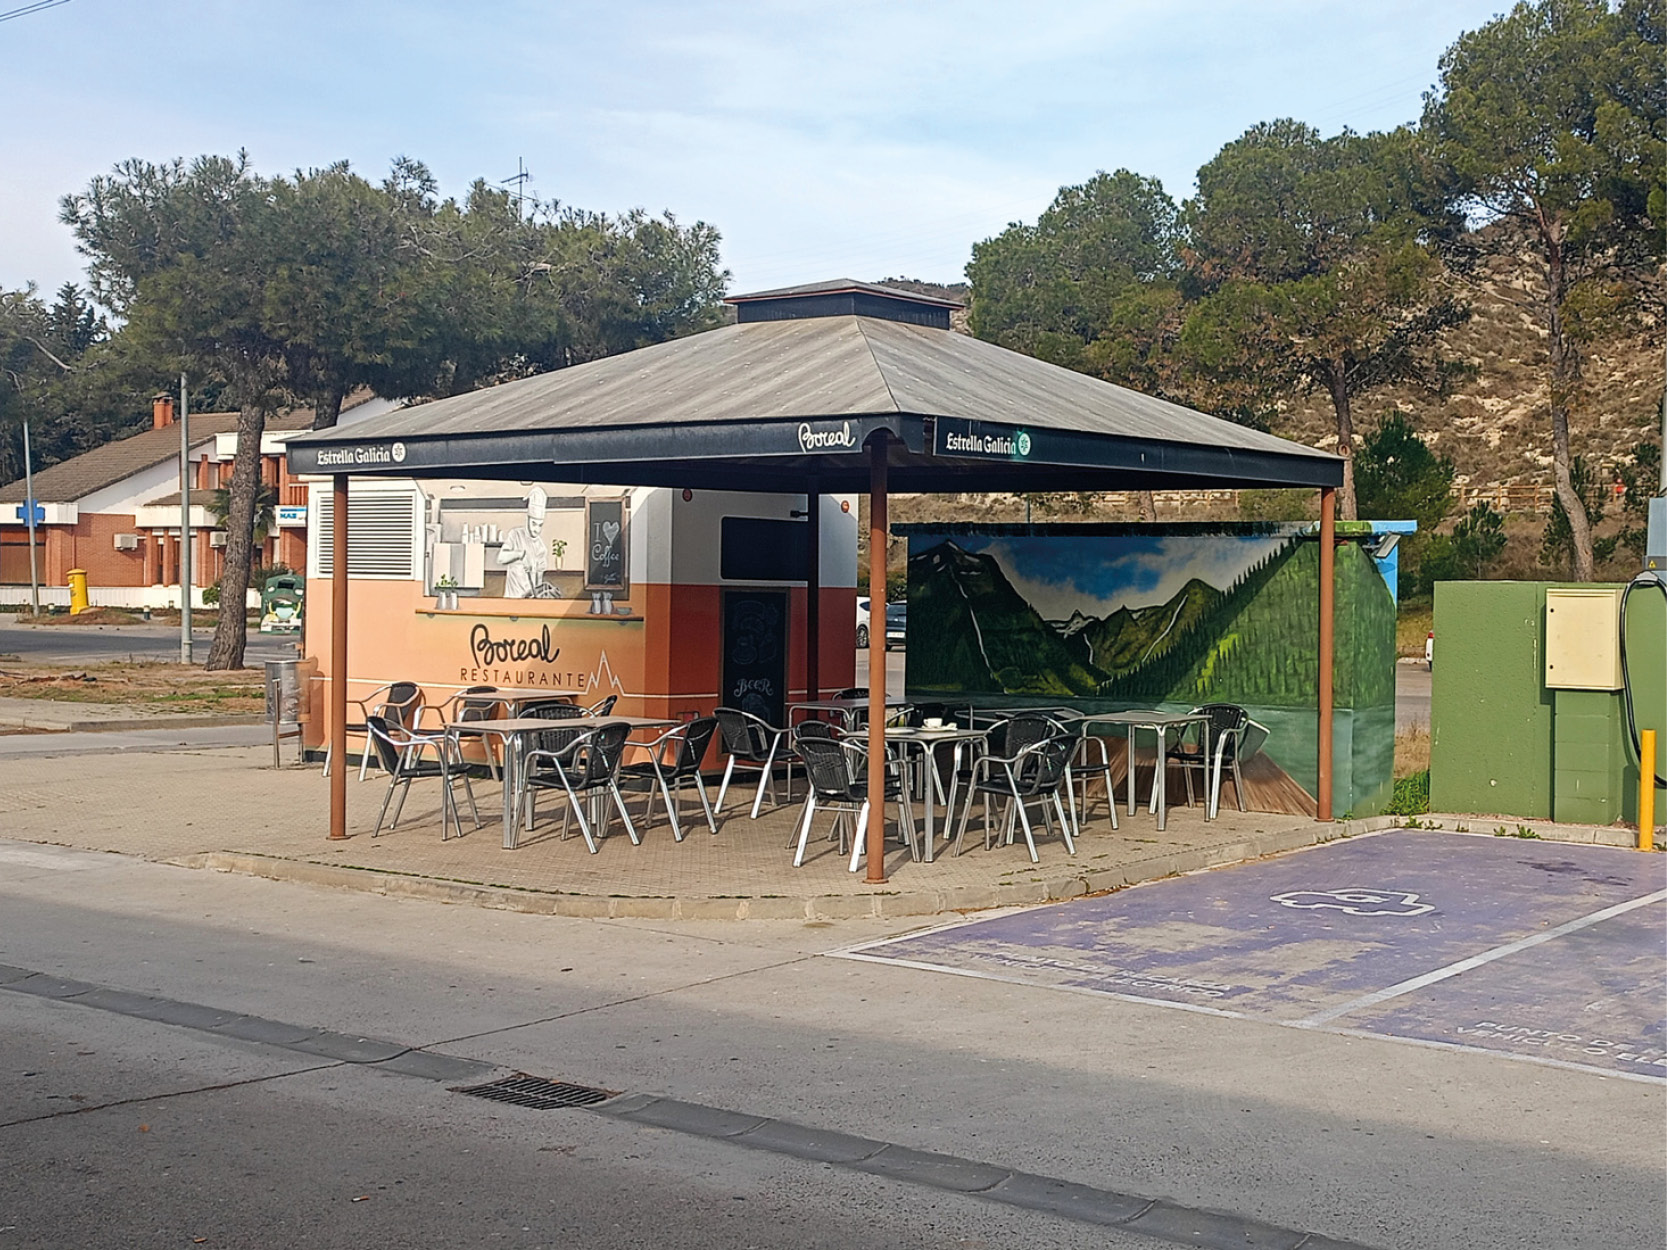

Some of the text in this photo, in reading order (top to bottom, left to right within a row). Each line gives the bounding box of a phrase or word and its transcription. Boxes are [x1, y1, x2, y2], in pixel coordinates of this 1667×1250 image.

[798, 421, 856, 454] Boreal
[946, 432, 1017, 455] Estrella Galicia
[317, 446, 391, 465] Estrella Galicia
[592, 543, 620, 568] Coffee
[470, 623, 560, 669] Boreal
[460, 668, 585, 688] RESTAURANTE
[1475, 1022, 1581, 1042] PUNTO
[1590, 1040, 1635, 1051] DE
